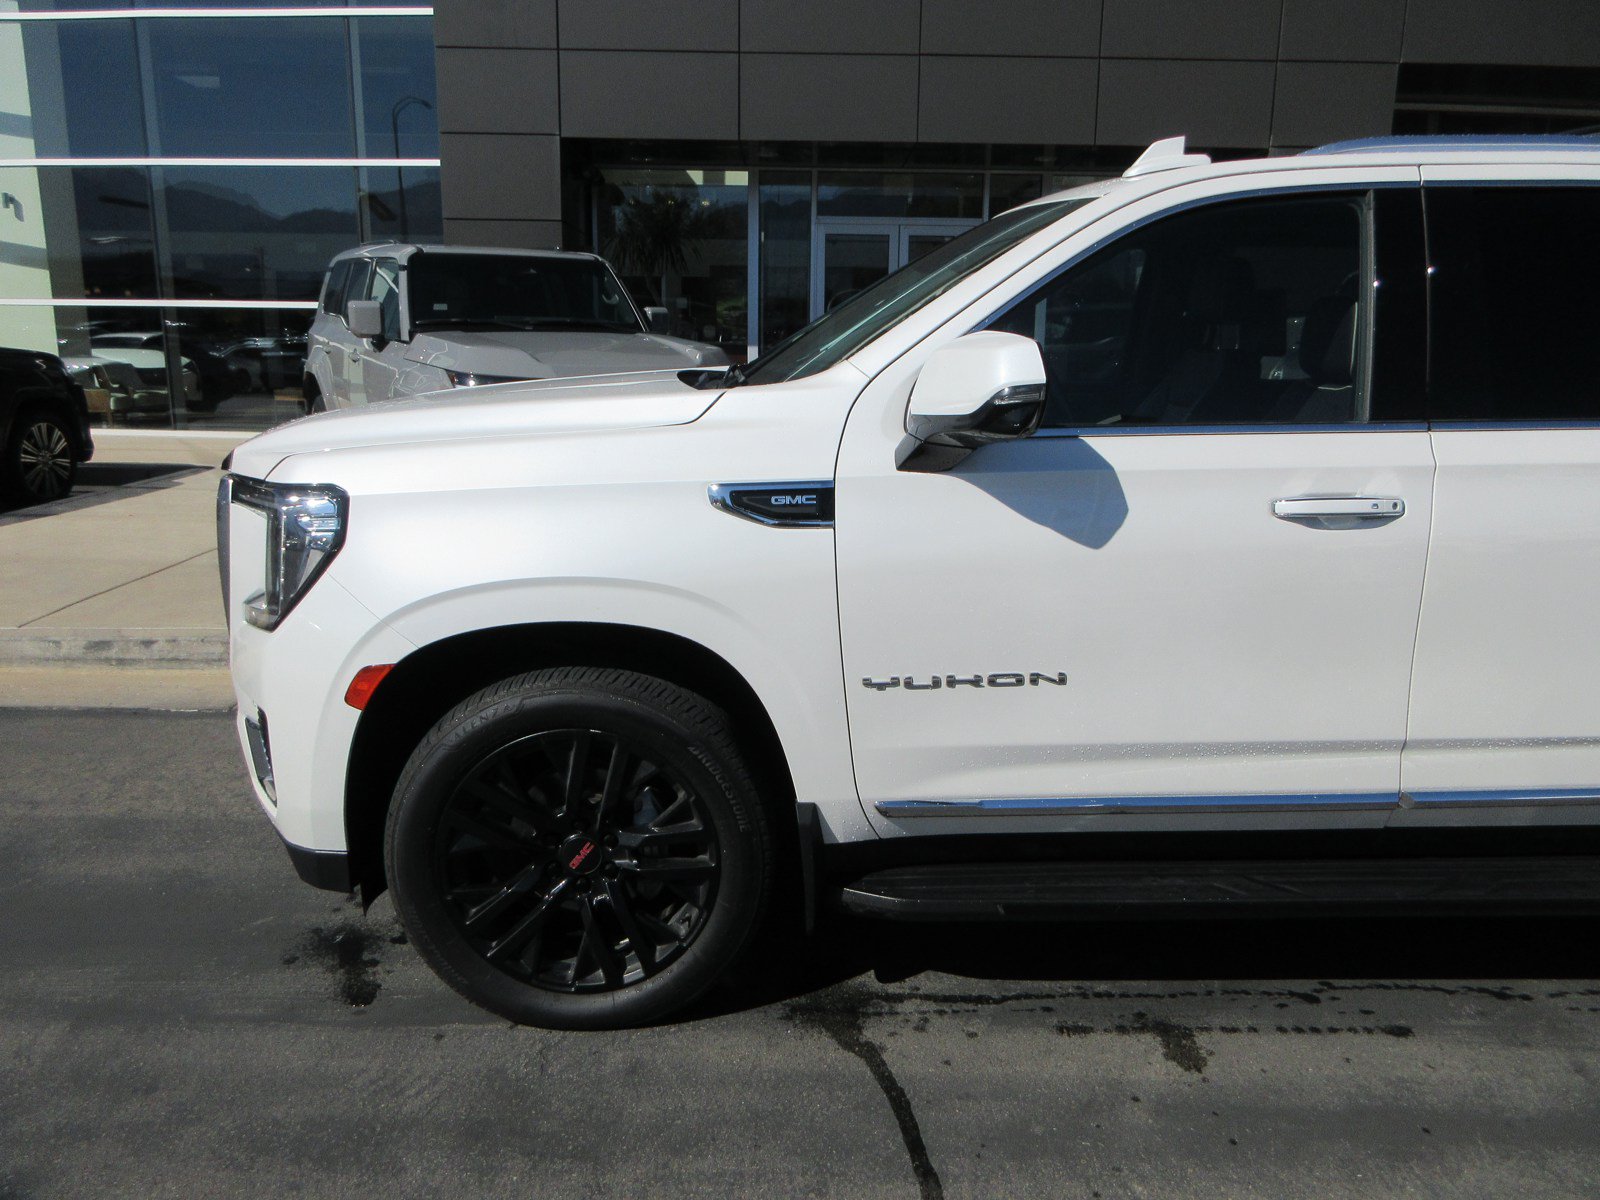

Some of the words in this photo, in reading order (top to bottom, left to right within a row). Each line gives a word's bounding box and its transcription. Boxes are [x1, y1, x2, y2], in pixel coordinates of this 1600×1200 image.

[770, 494, 817, 506] GMC
[862, 671, 1068, 691] YUKON
[687, 742, 753, 834] BRIDGESTONE
[568, 841, 595, 870] GMC
